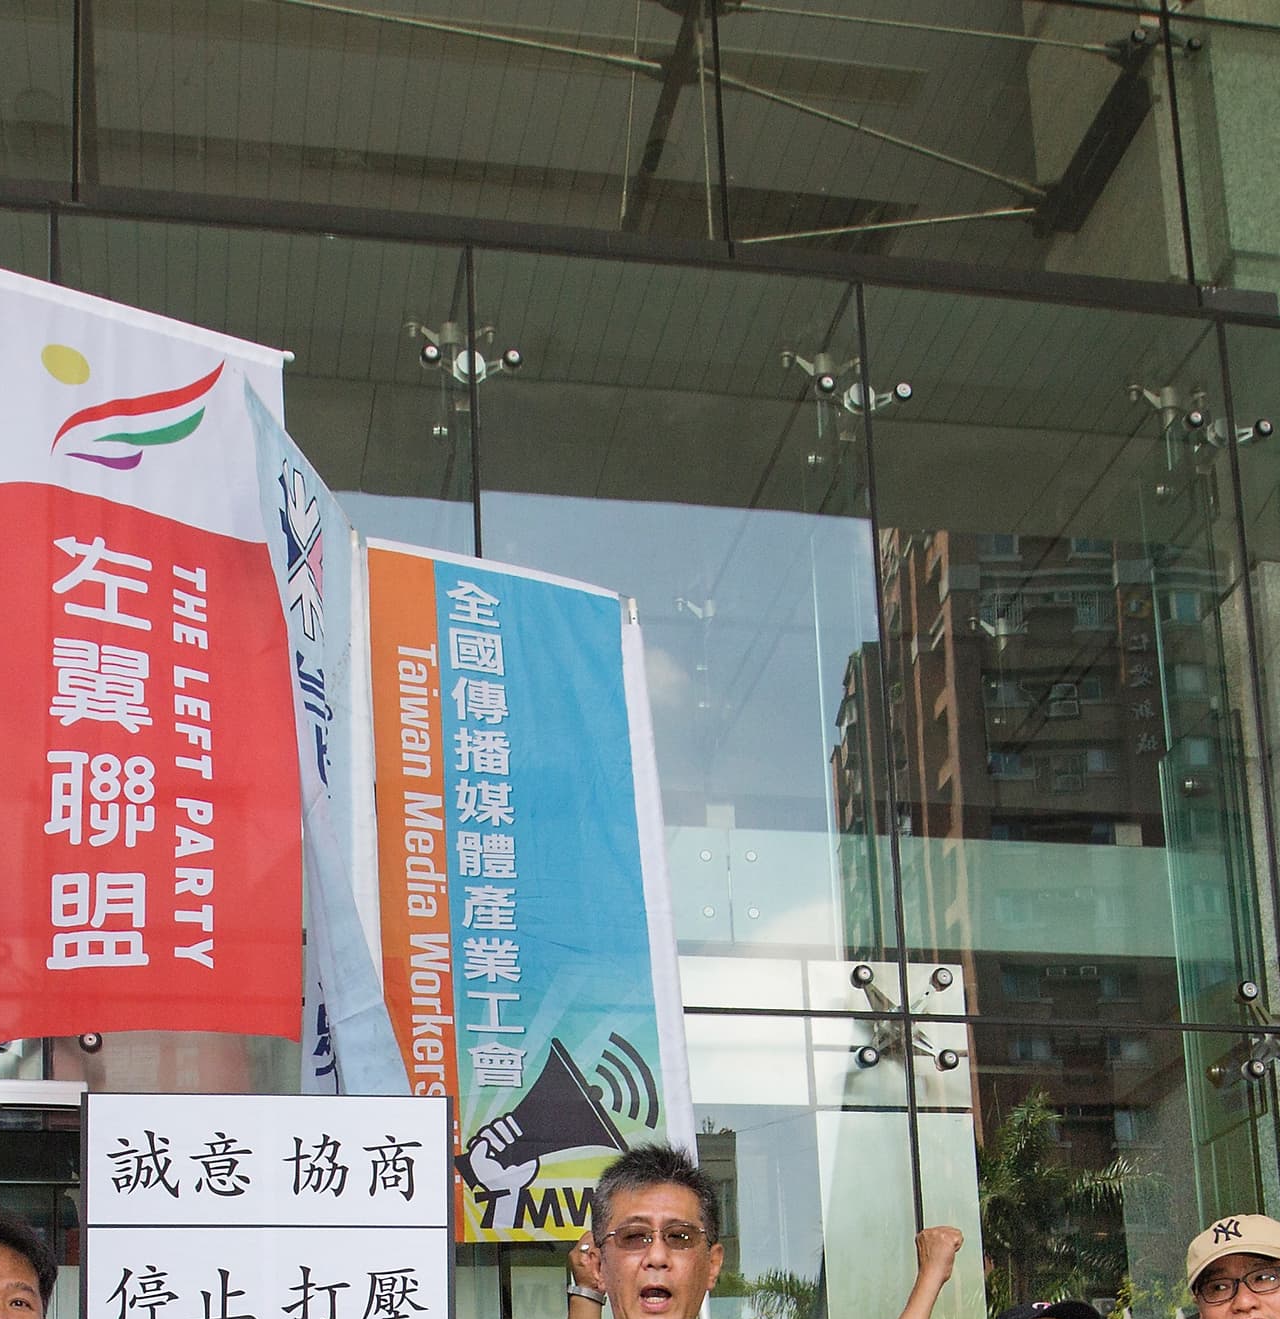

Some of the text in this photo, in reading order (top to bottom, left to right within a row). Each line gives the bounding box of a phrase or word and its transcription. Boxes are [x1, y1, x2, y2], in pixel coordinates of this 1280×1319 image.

[44, 536, 155, 970] 左翼聯盟
[173, 567, 214, 970] THE LEFT PARTY
[397, 643, 439, 777] Taiwan
[446, 580, 527, 1087] 全國傳播媒體產業工會
[404, 791, 449, 918] Media
[106, 1130, 422, 1202] 誠意協商
